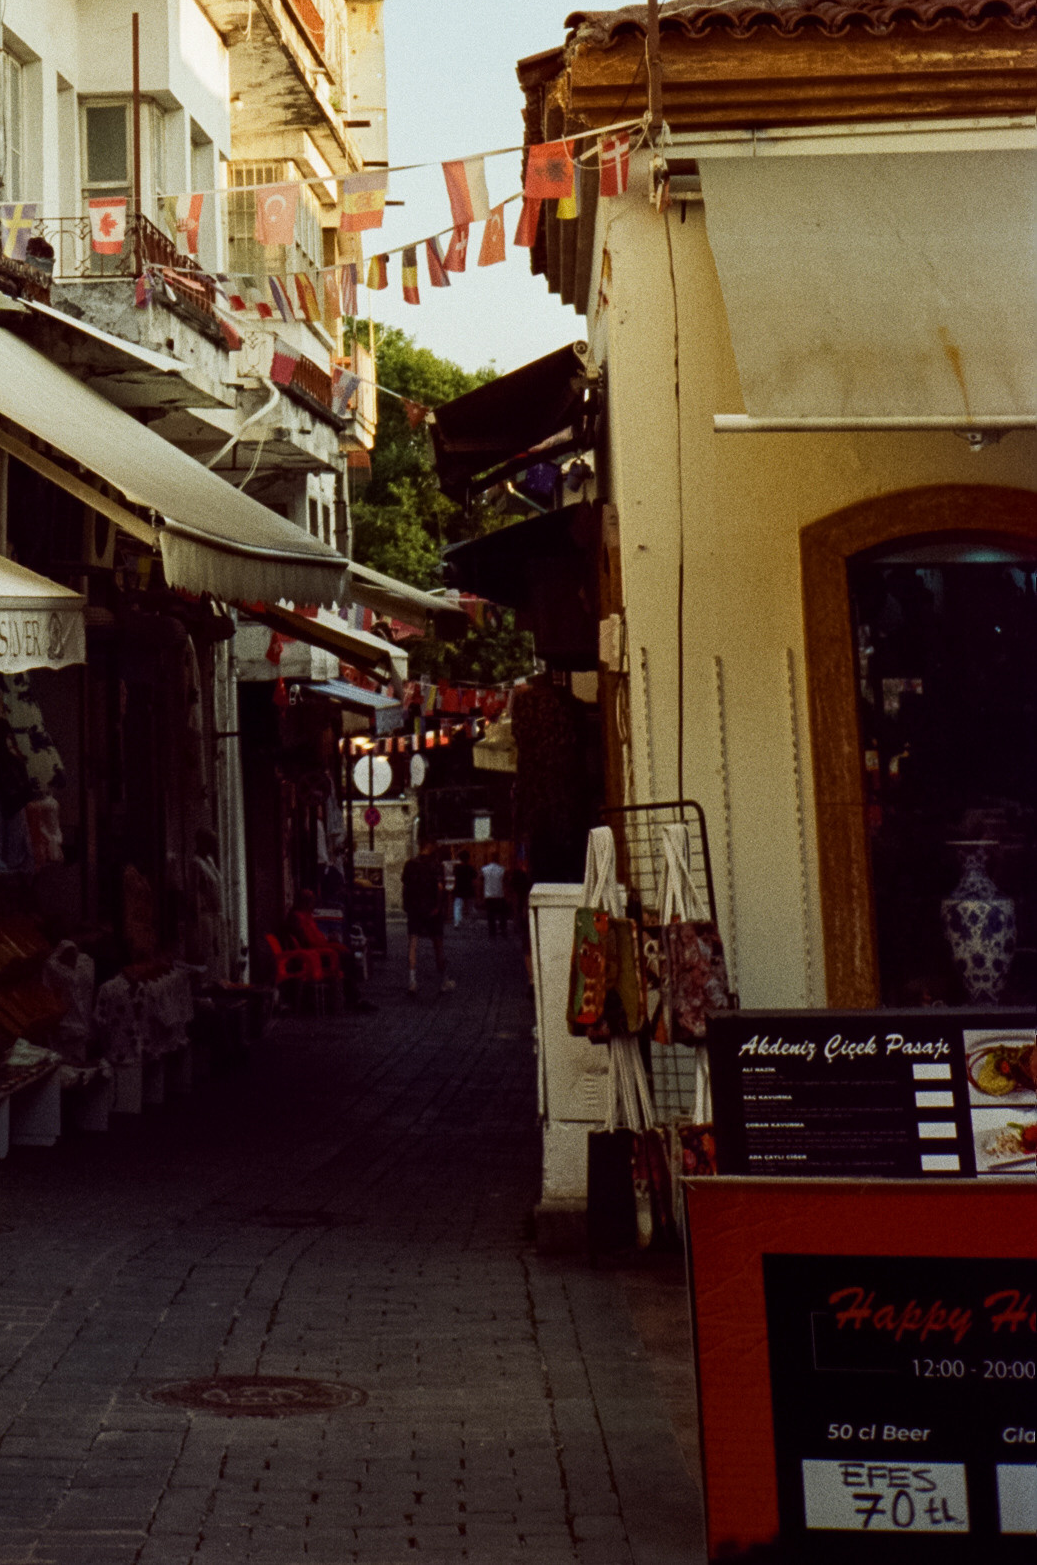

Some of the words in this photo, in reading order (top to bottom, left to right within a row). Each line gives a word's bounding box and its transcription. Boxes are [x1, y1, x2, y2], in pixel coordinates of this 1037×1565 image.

[738, 1034, 818, 1061] Akdeniz
[824, 1034, 878, 1064] Çiçek
[828, 1286, 973, 1344] Happy
[912, 1359, 965, 1378] 12:00
[983, 1360, 1037, 1379] 20:00
[827, 1423, 853, 1440] 50
[858, 1424, 876, 1441] cl
[882, 1424, 931, 1442] Beer
[838, 1462, 937, 1492] EFES
[851, 1488, 915, 1529] 70
